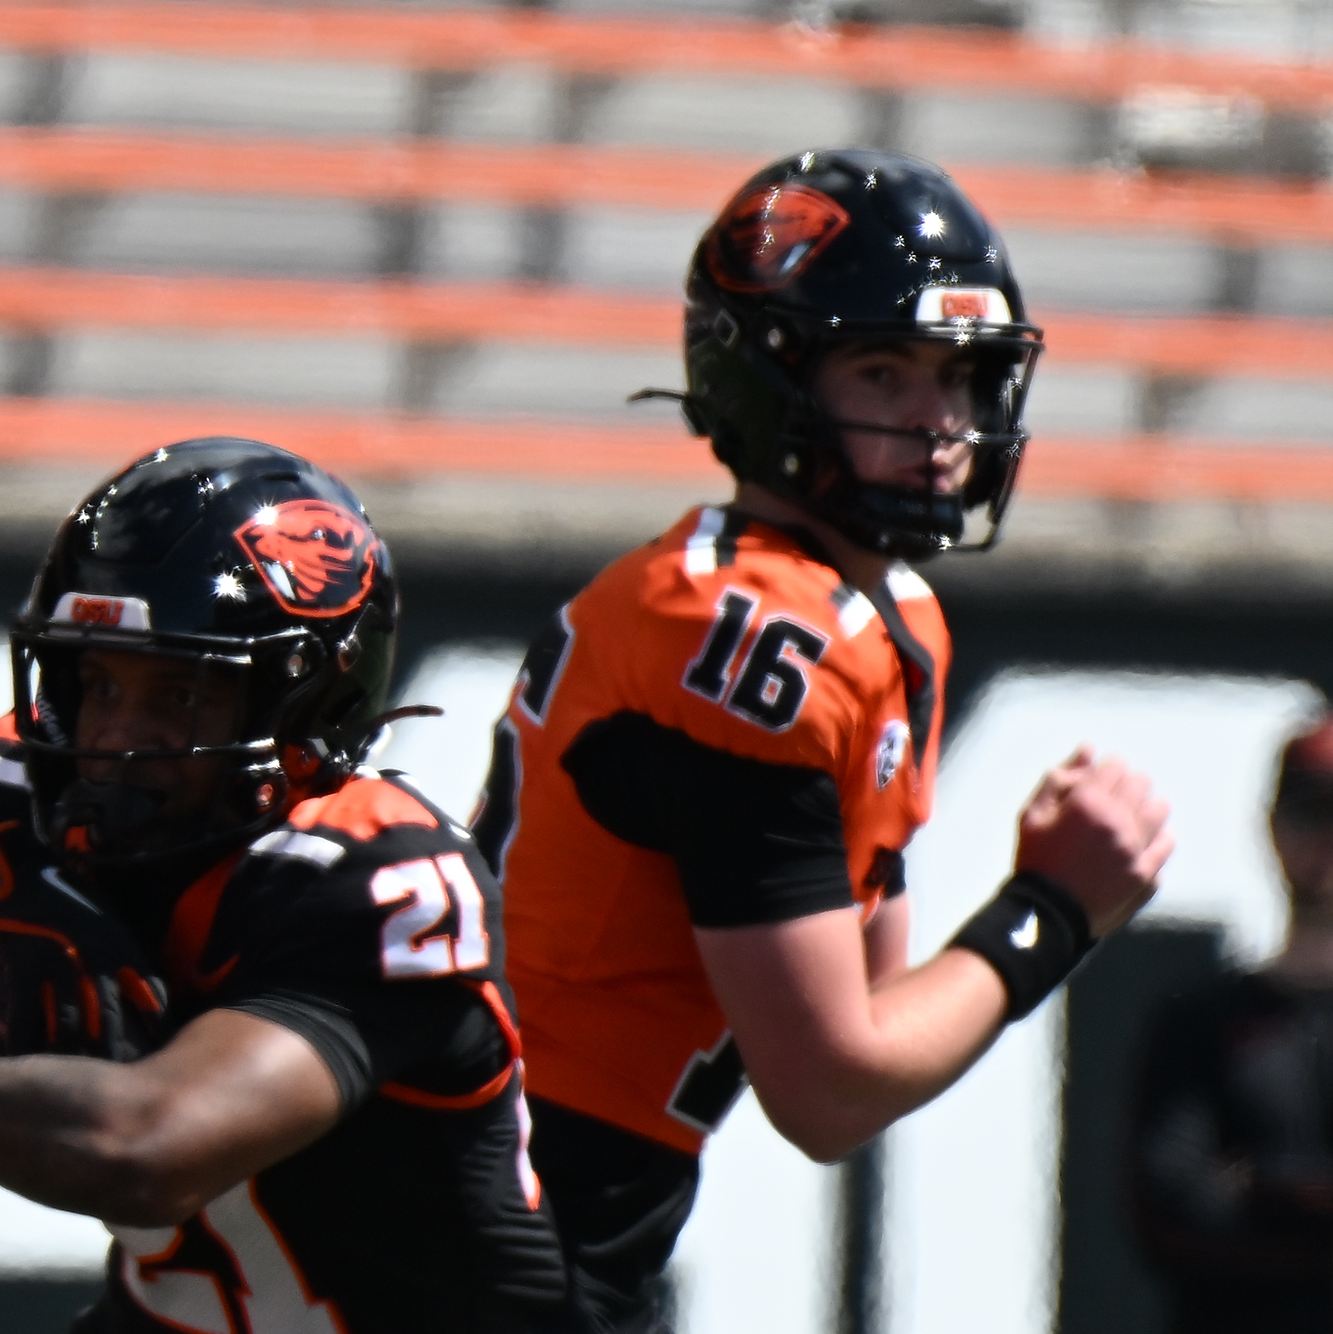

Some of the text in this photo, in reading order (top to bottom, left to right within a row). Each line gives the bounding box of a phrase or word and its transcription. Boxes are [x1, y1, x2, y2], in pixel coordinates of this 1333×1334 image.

[70, 596, 126, 627] OSU
[681, 584, 829, 734] 16
[369, 852, 491, 981] 21
